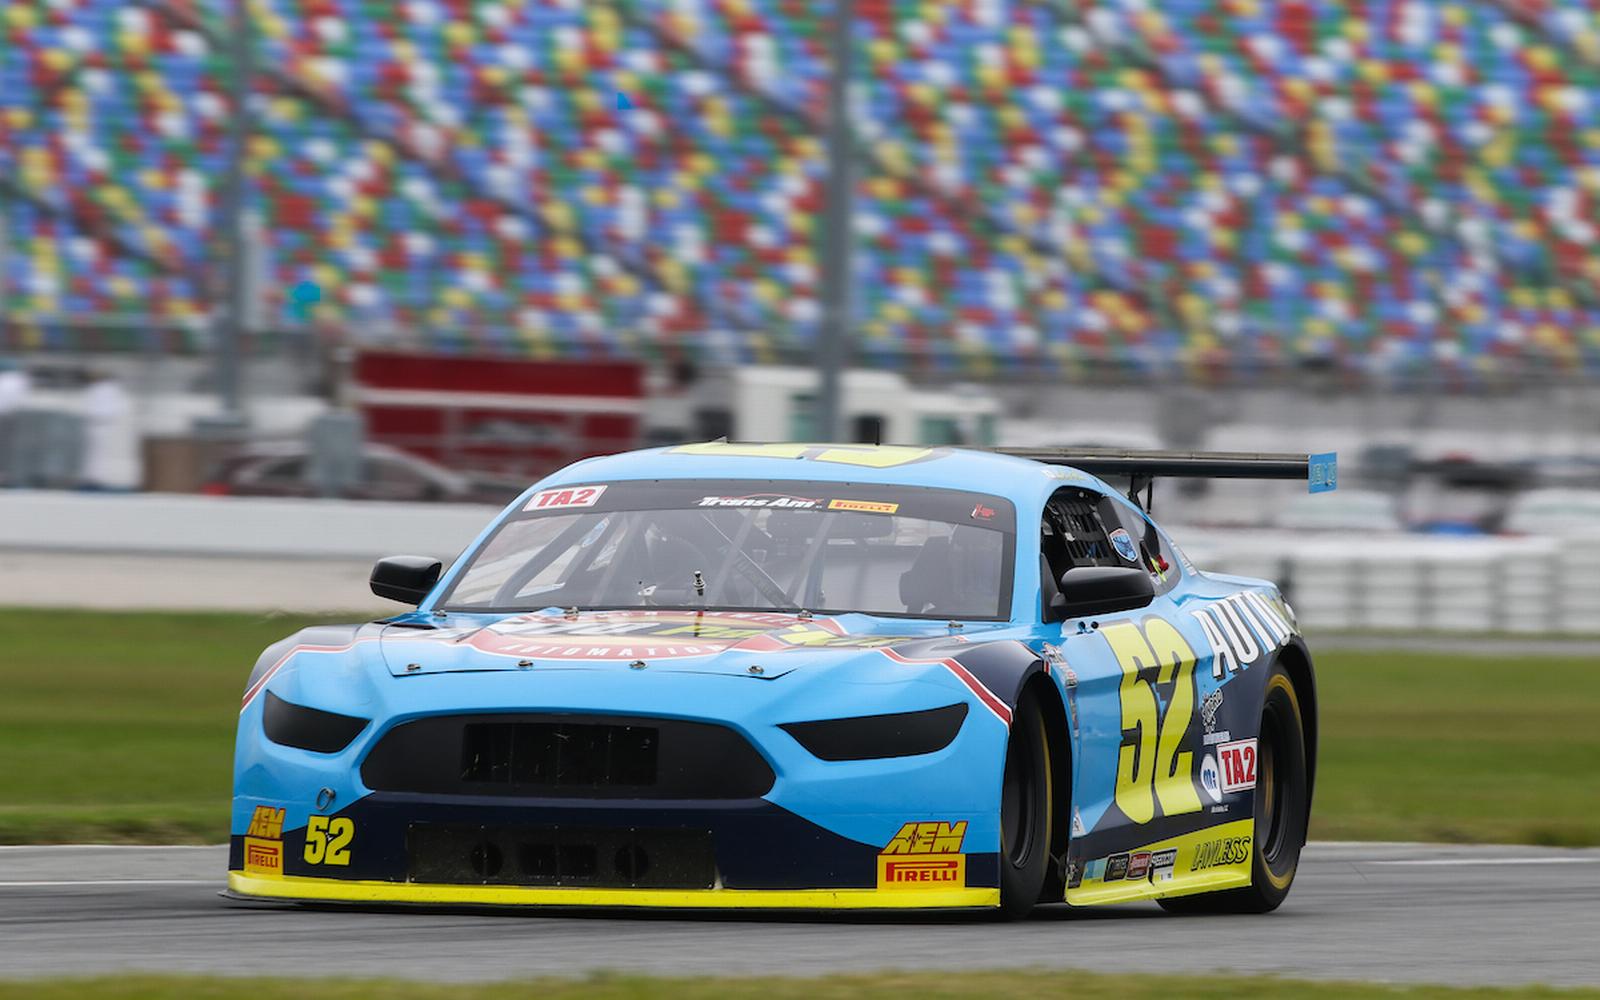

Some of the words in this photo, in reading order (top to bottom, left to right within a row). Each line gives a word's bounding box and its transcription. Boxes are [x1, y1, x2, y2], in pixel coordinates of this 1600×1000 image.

[536, 489, 596, 508] TA2
[498, 643, 728, 658] AUTOMATION
[1100, 618, 1203, 825] 52
[1221, 746, 1256, 786] TA2
[246, 805, 287, 840] AEM
[880, 820, 968, 855] AEM
[248, 844, 279, 868] PIRELLI
[304, 815, 355, 866] 52
[1190, 836, 1252, 873] LAWLESS
[886, 860, 958, 882] PIRELLI
